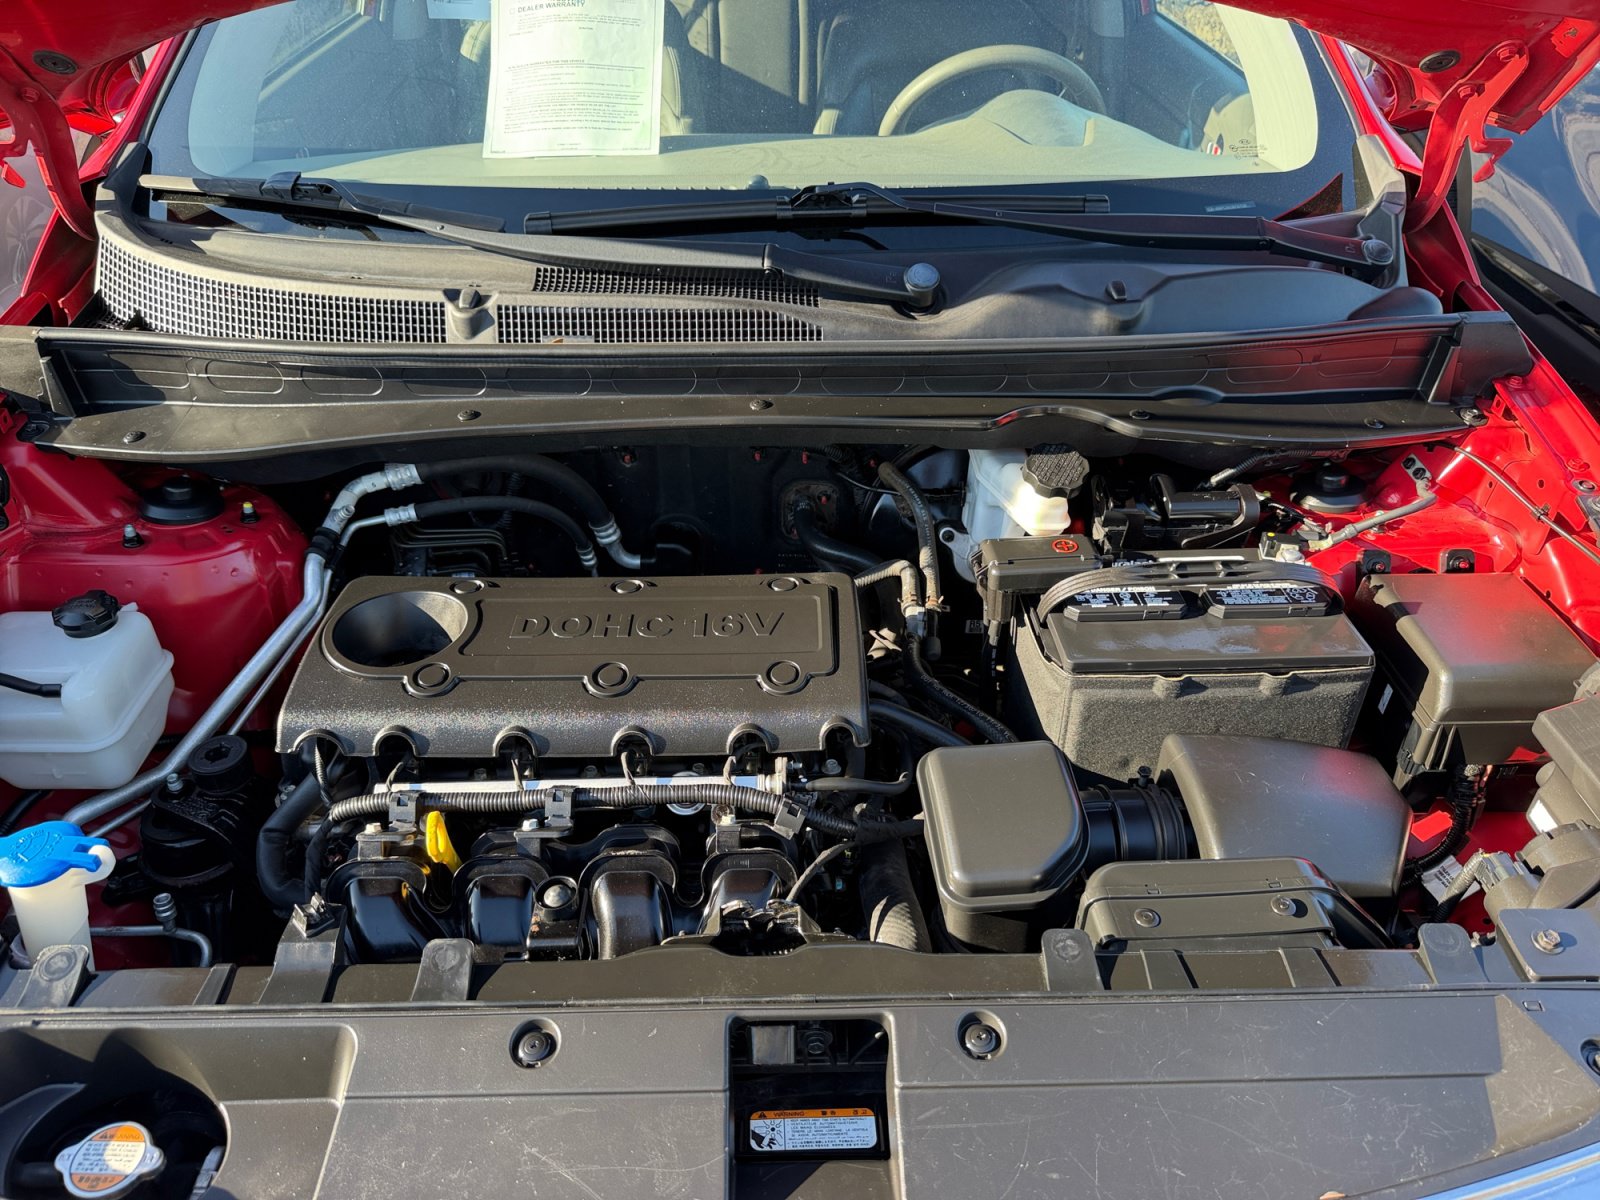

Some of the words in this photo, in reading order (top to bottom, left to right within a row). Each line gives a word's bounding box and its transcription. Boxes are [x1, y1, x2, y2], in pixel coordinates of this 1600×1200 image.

[517, 3, 544, 13] DEALER
[545, 0, 585, 8] WARRANTY
[509, 613, 674, 638] DOHC
[684, 612, 785, 638] 16V
